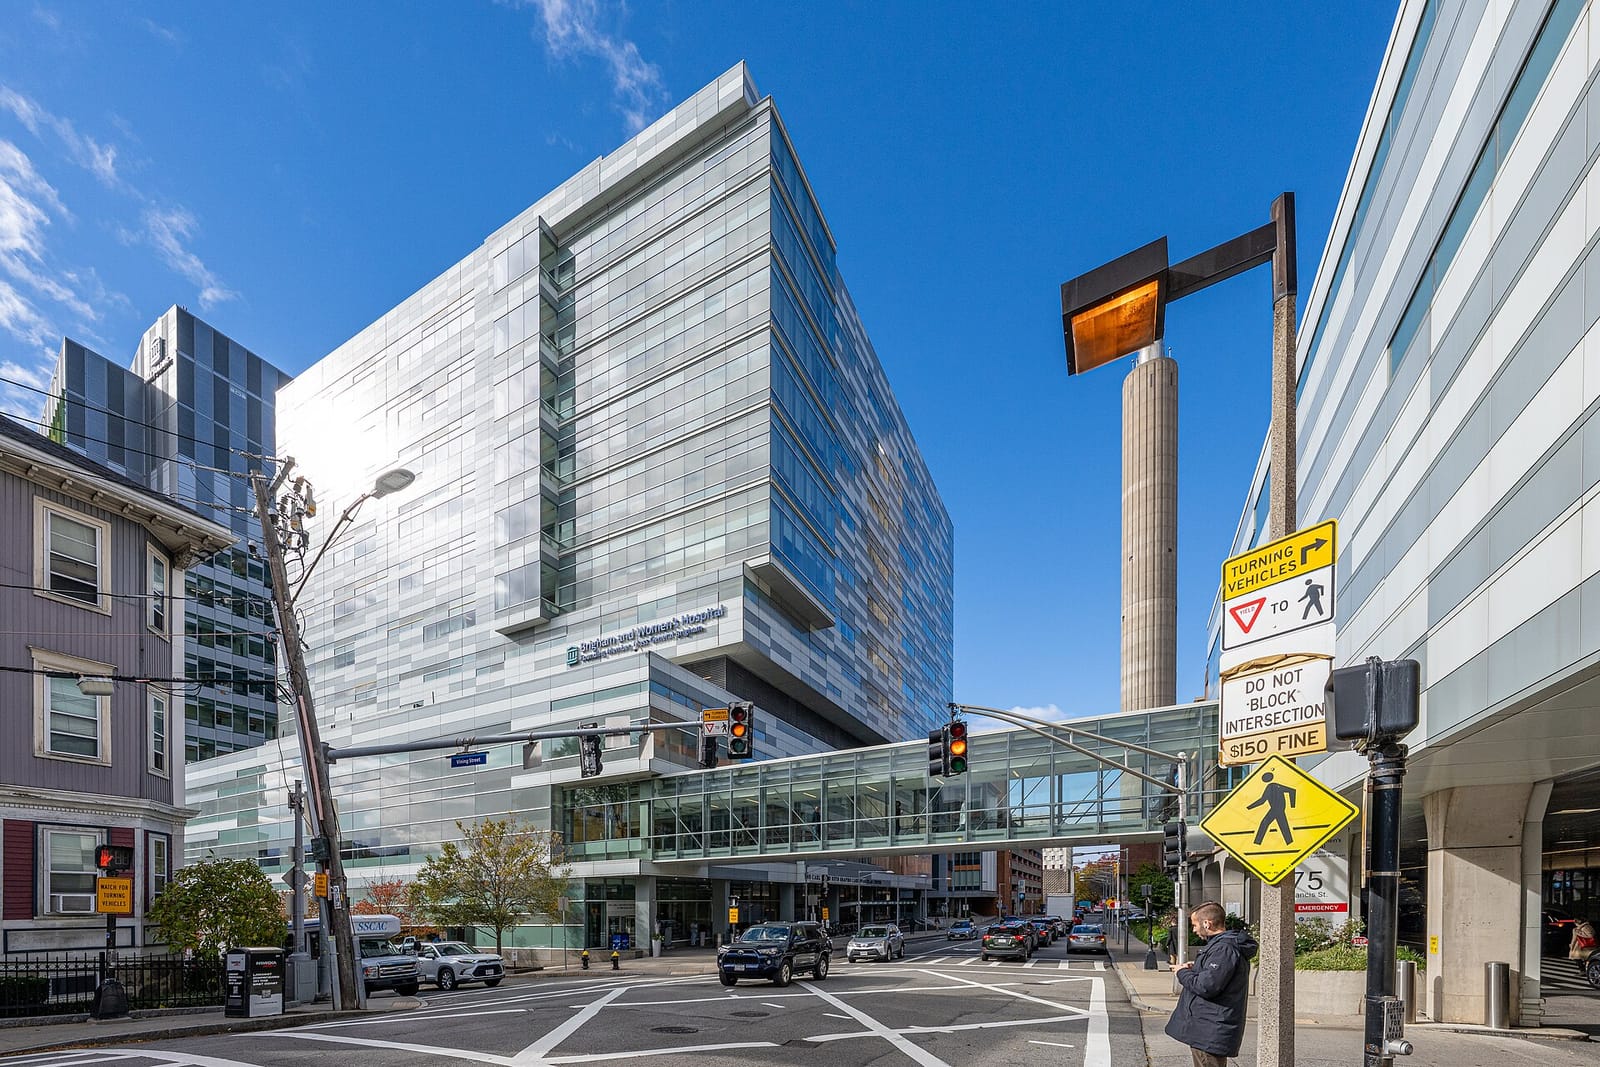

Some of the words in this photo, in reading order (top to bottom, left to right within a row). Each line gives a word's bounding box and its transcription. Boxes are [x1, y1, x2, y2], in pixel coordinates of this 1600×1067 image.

[1231, 546, 1294, 577] TURNING
[1228, 560, 1297, 593] VEHICLES
[1240, 606, 1256, 615] YIELD
[1270, 600, 1289, 614] TO
[581, 637, 617, 652] Brigham
[619, 628, 636, 643] and
[637, 616, 680, 637] Women's
[682, 604, 725, 626] Hospital
[1246, 677, 1265, 694] DO
[1273, 669, 1303, 687] NOT
[1250, 689, 1297, 711] BLOCK
[1225, 703, 1325, 734] INTERSECTION
[1230, 739, 1268, 758] $150
[1277, 730, 1319, 750] FINE
[1295, 871, 1323, 890] 75
[357, 921, 387, 931] SSCAC
